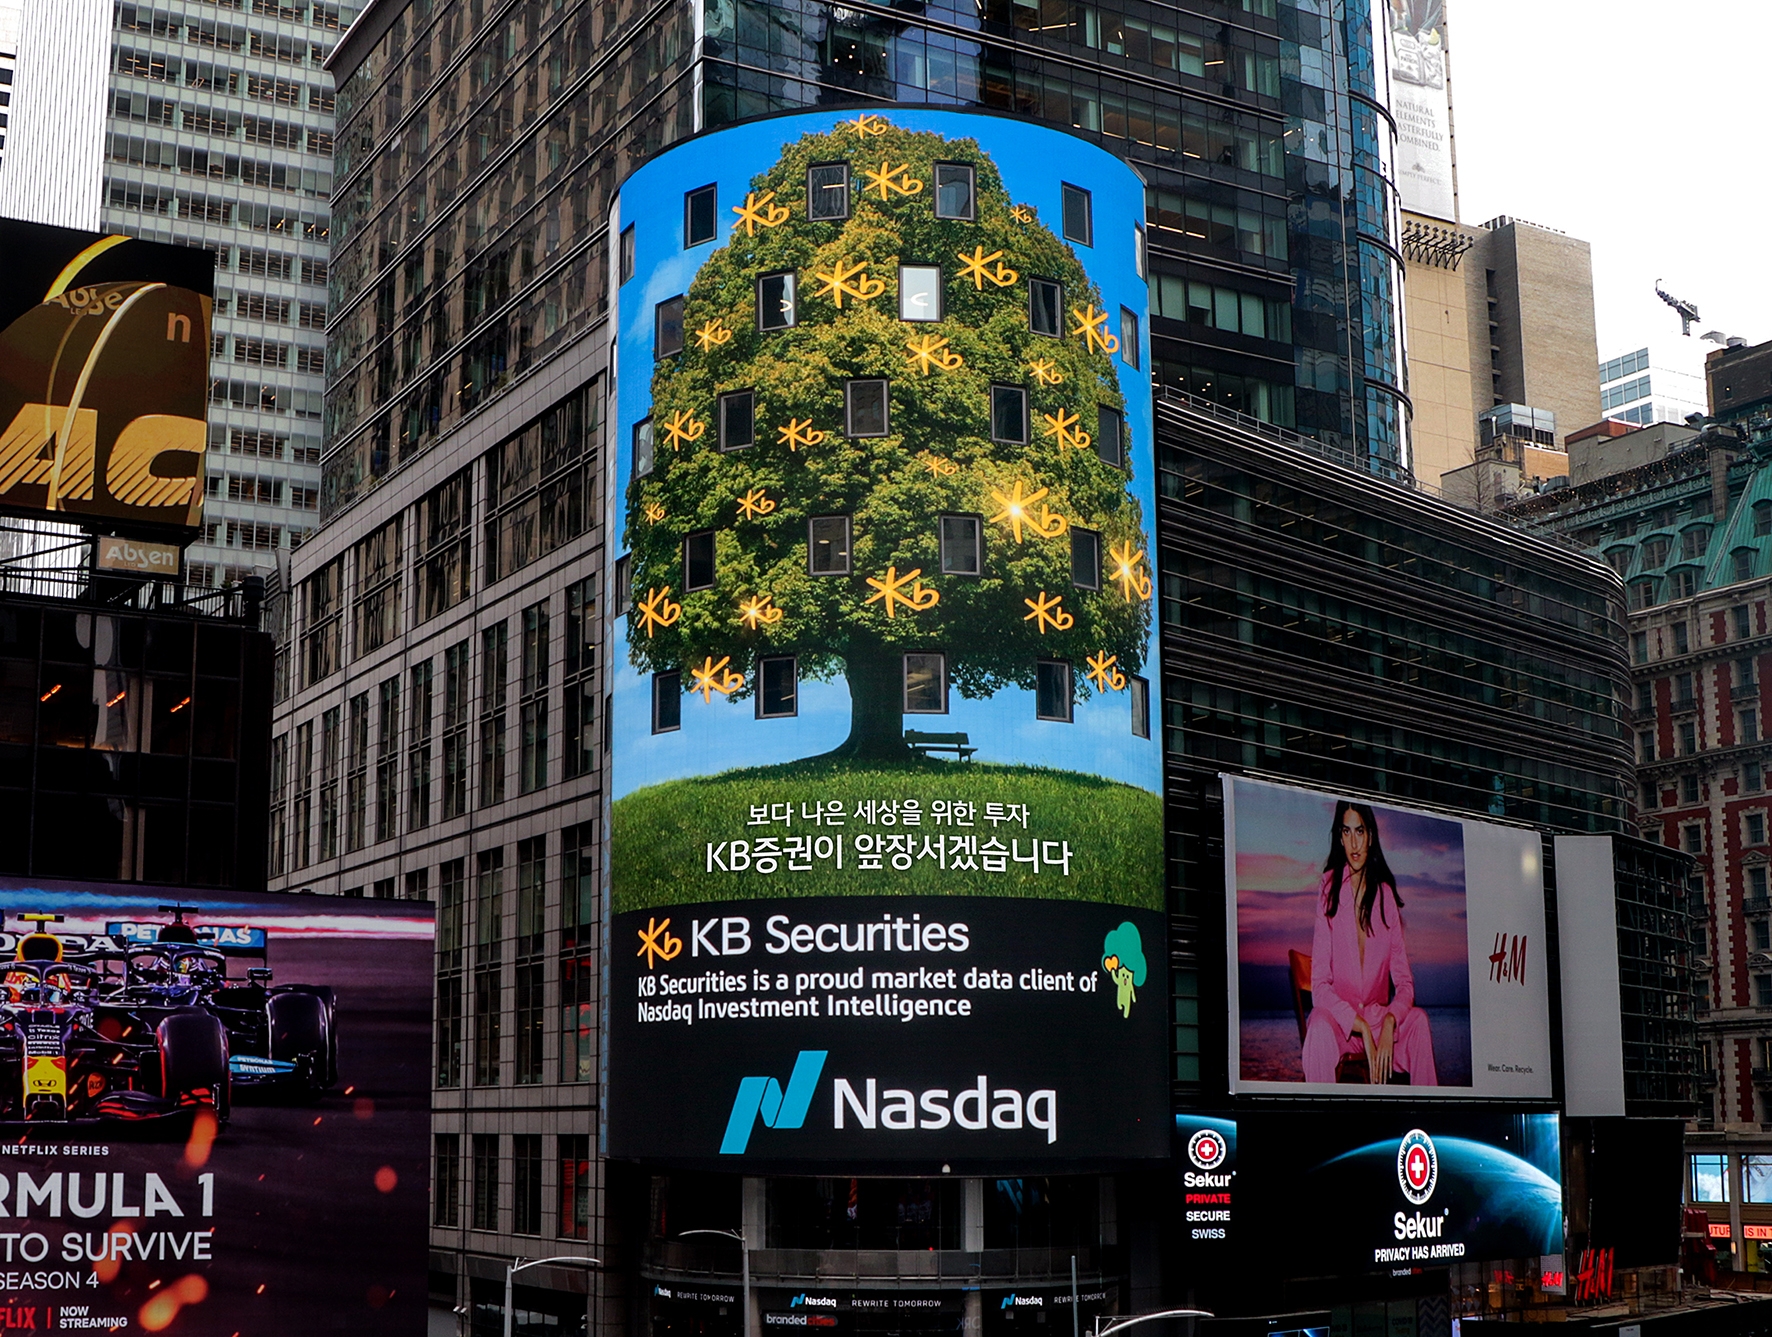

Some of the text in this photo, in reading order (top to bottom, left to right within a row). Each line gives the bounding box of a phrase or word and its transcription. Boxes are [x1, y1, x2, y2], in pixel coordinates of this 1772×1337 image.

[1395, 100, 1434, 117] NATURAL
[1396, 110, 1436, 129] ELEMENTS
[1397, 122, 1444, 142] ASTERFULLY
[106, 543, 173, 568] Absen
[747, 799, 1031, 829] 보다 나은 세상을 위한 투자
[706, 833, 1074, 876] KB증권이 앞장서겠습니다
[691, 917, 751, 957] KB
[765, 914, 970, 954] Securities
[1489, 932, 1527, 987] H&M
[638, 967, 1098, 997] KB Securities is a proud market data client of
[638, 994, 971, 1025] Nasdaq Investment Intelligence
[833, 1075, 1057, 1145] Nasdaq
[2, 1145, 109, 1155] NETFLIX SERIES
[1184, 1171, 1232, 1187] Sekur
[198, 1172, 214, 1217] 1
[1185, 1193, 1231, 1204] PRIVATE
[1186, 1210, 1231, 1221] SECURE
[1191, 1228, 1226, 1239] SWISS
[1394, 1211, 1444, 1240] Sekur
[1745, 1227, 1754, 1237] IS
[1757, 1227, 1767, 1237] IN
[0, 1231, 212, 1262] TO SURVIVE
[1374, 1243, 1465, 1262] PRIVACY HAS ARRIVED
[86, 1271, 99, 1288] 4
[805, 1297, 837, 1308] Nasdaq
[1015, 1296, 1043, 1306] Nasdaq
[1054, 1295, 1079, 1304] REWRIE
[60, 1306, 89, 1317] NOW
[59, 1317, 128, 1329] STREAMING
